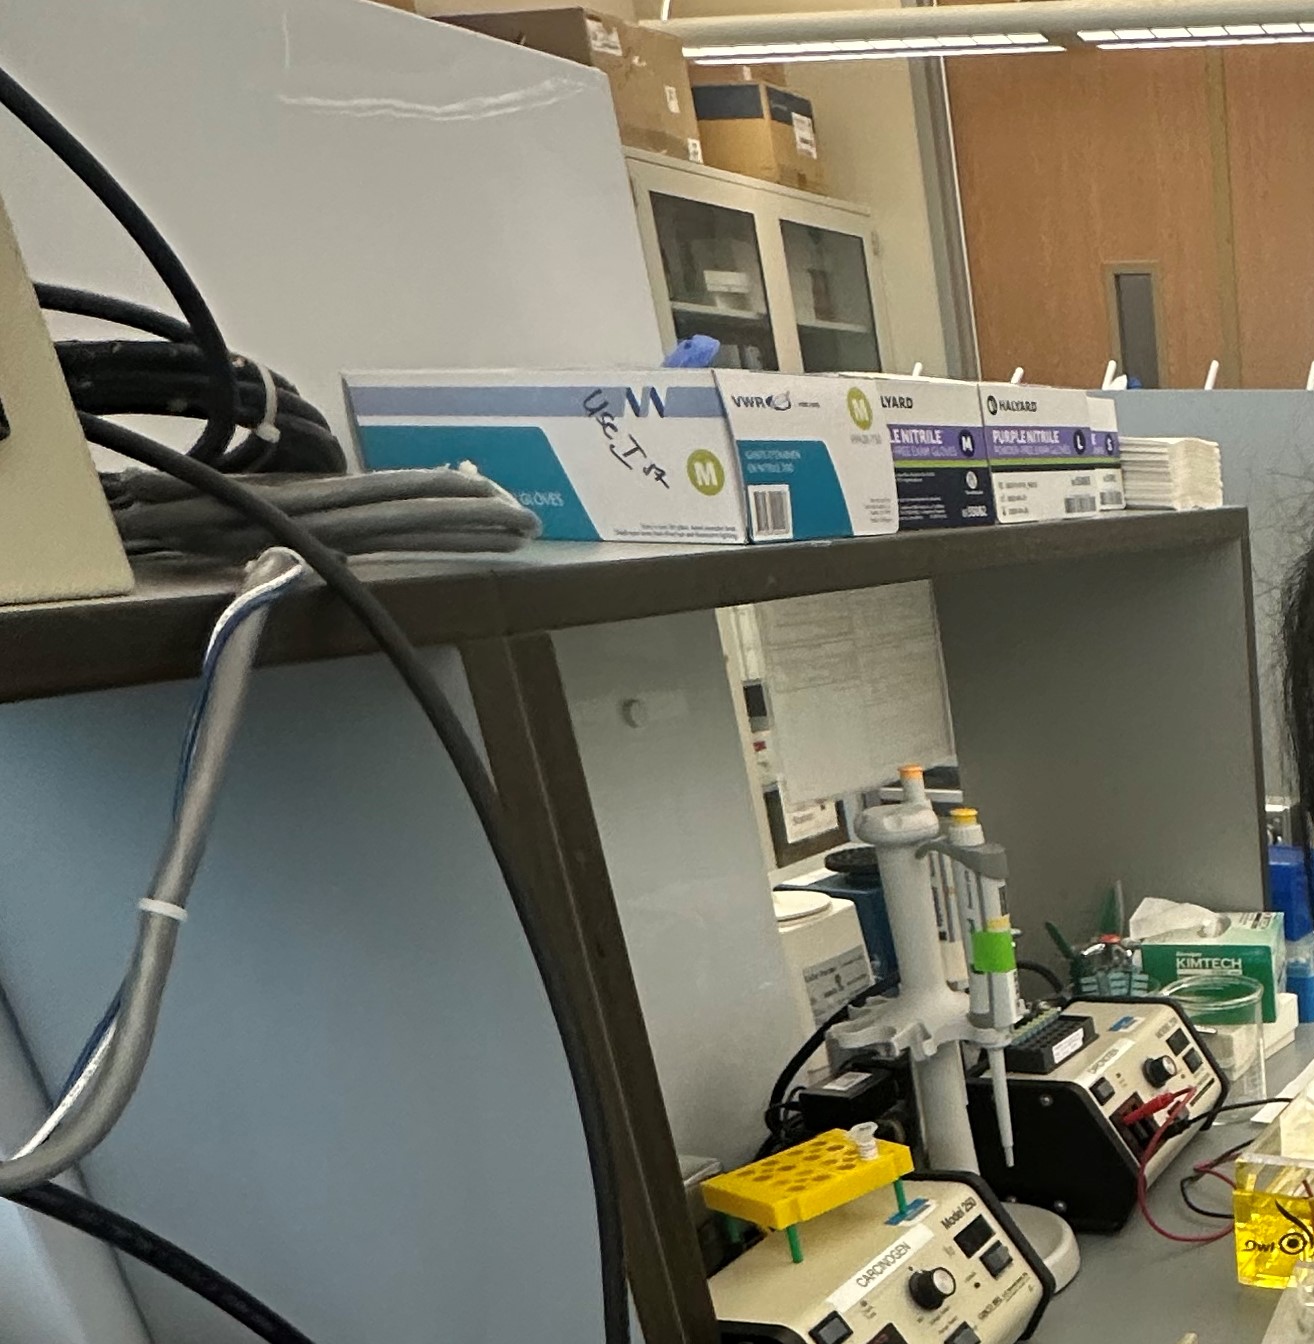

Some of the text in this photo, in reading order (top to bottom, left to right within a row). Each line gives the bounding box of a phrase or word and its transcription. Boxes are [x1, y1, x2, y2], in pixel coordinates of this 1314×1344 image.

[880, 395, 913, 409] LYARD
[999, 400, 1038, 413] HALYARD
[900, 428, 943, 445] NITRILE
[1176, 957, 1243, 970] KIMTECH
[940, 1196, 978, 1231] Model 250
[856, 1241, 912, 1289] CARCINOGEN
